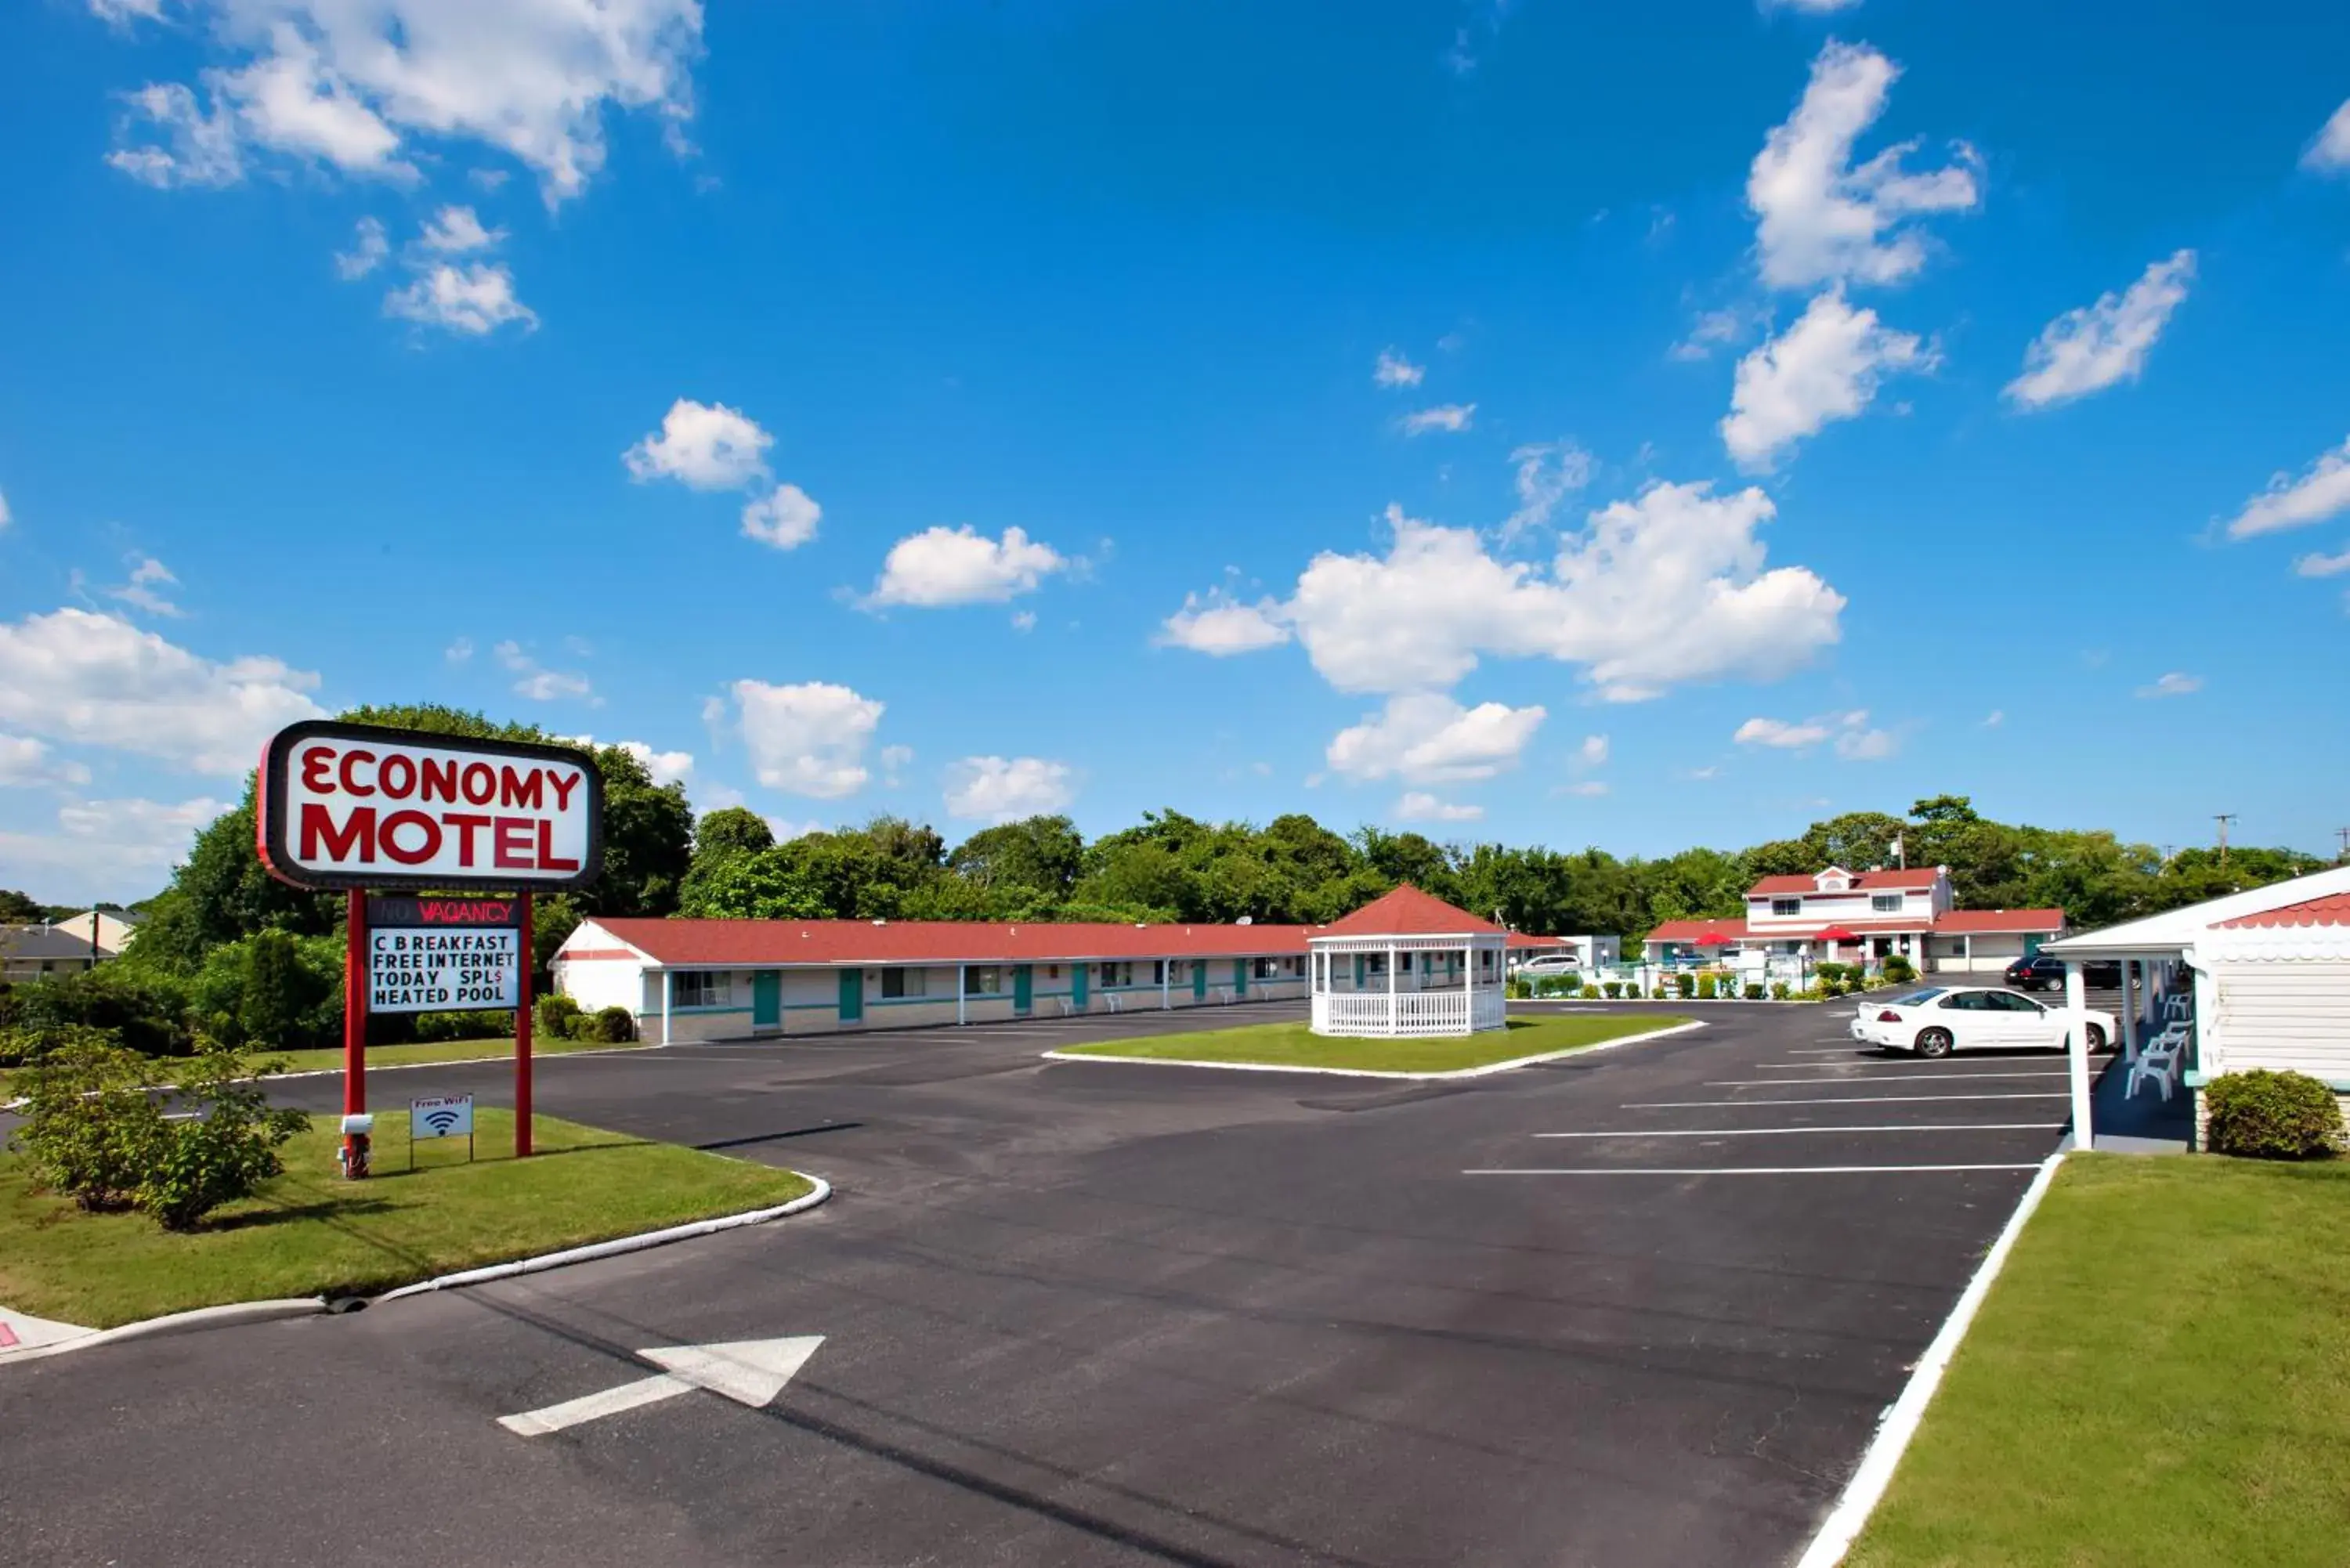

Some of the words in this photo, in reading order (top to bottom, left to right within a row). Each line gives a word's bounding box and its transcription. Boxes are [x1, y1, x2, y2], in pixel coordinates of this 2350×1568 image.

[302, 746, 580, 811] ECONOMY
[300, 803, 578, 871] MOTEL
[418, 902, 512, 922] VACANCY
[374, 937, 386, 951] C
[395, 936, 508, 951] BREAKFAST
[373, 954, 422, 969] FREE
[428, 952, 515, 968] INTERNET
[374, 970, 439, 987] TODAY
[375, 988, 448, 1005] HEATED
[457, 987, 504, 1002] POOL
